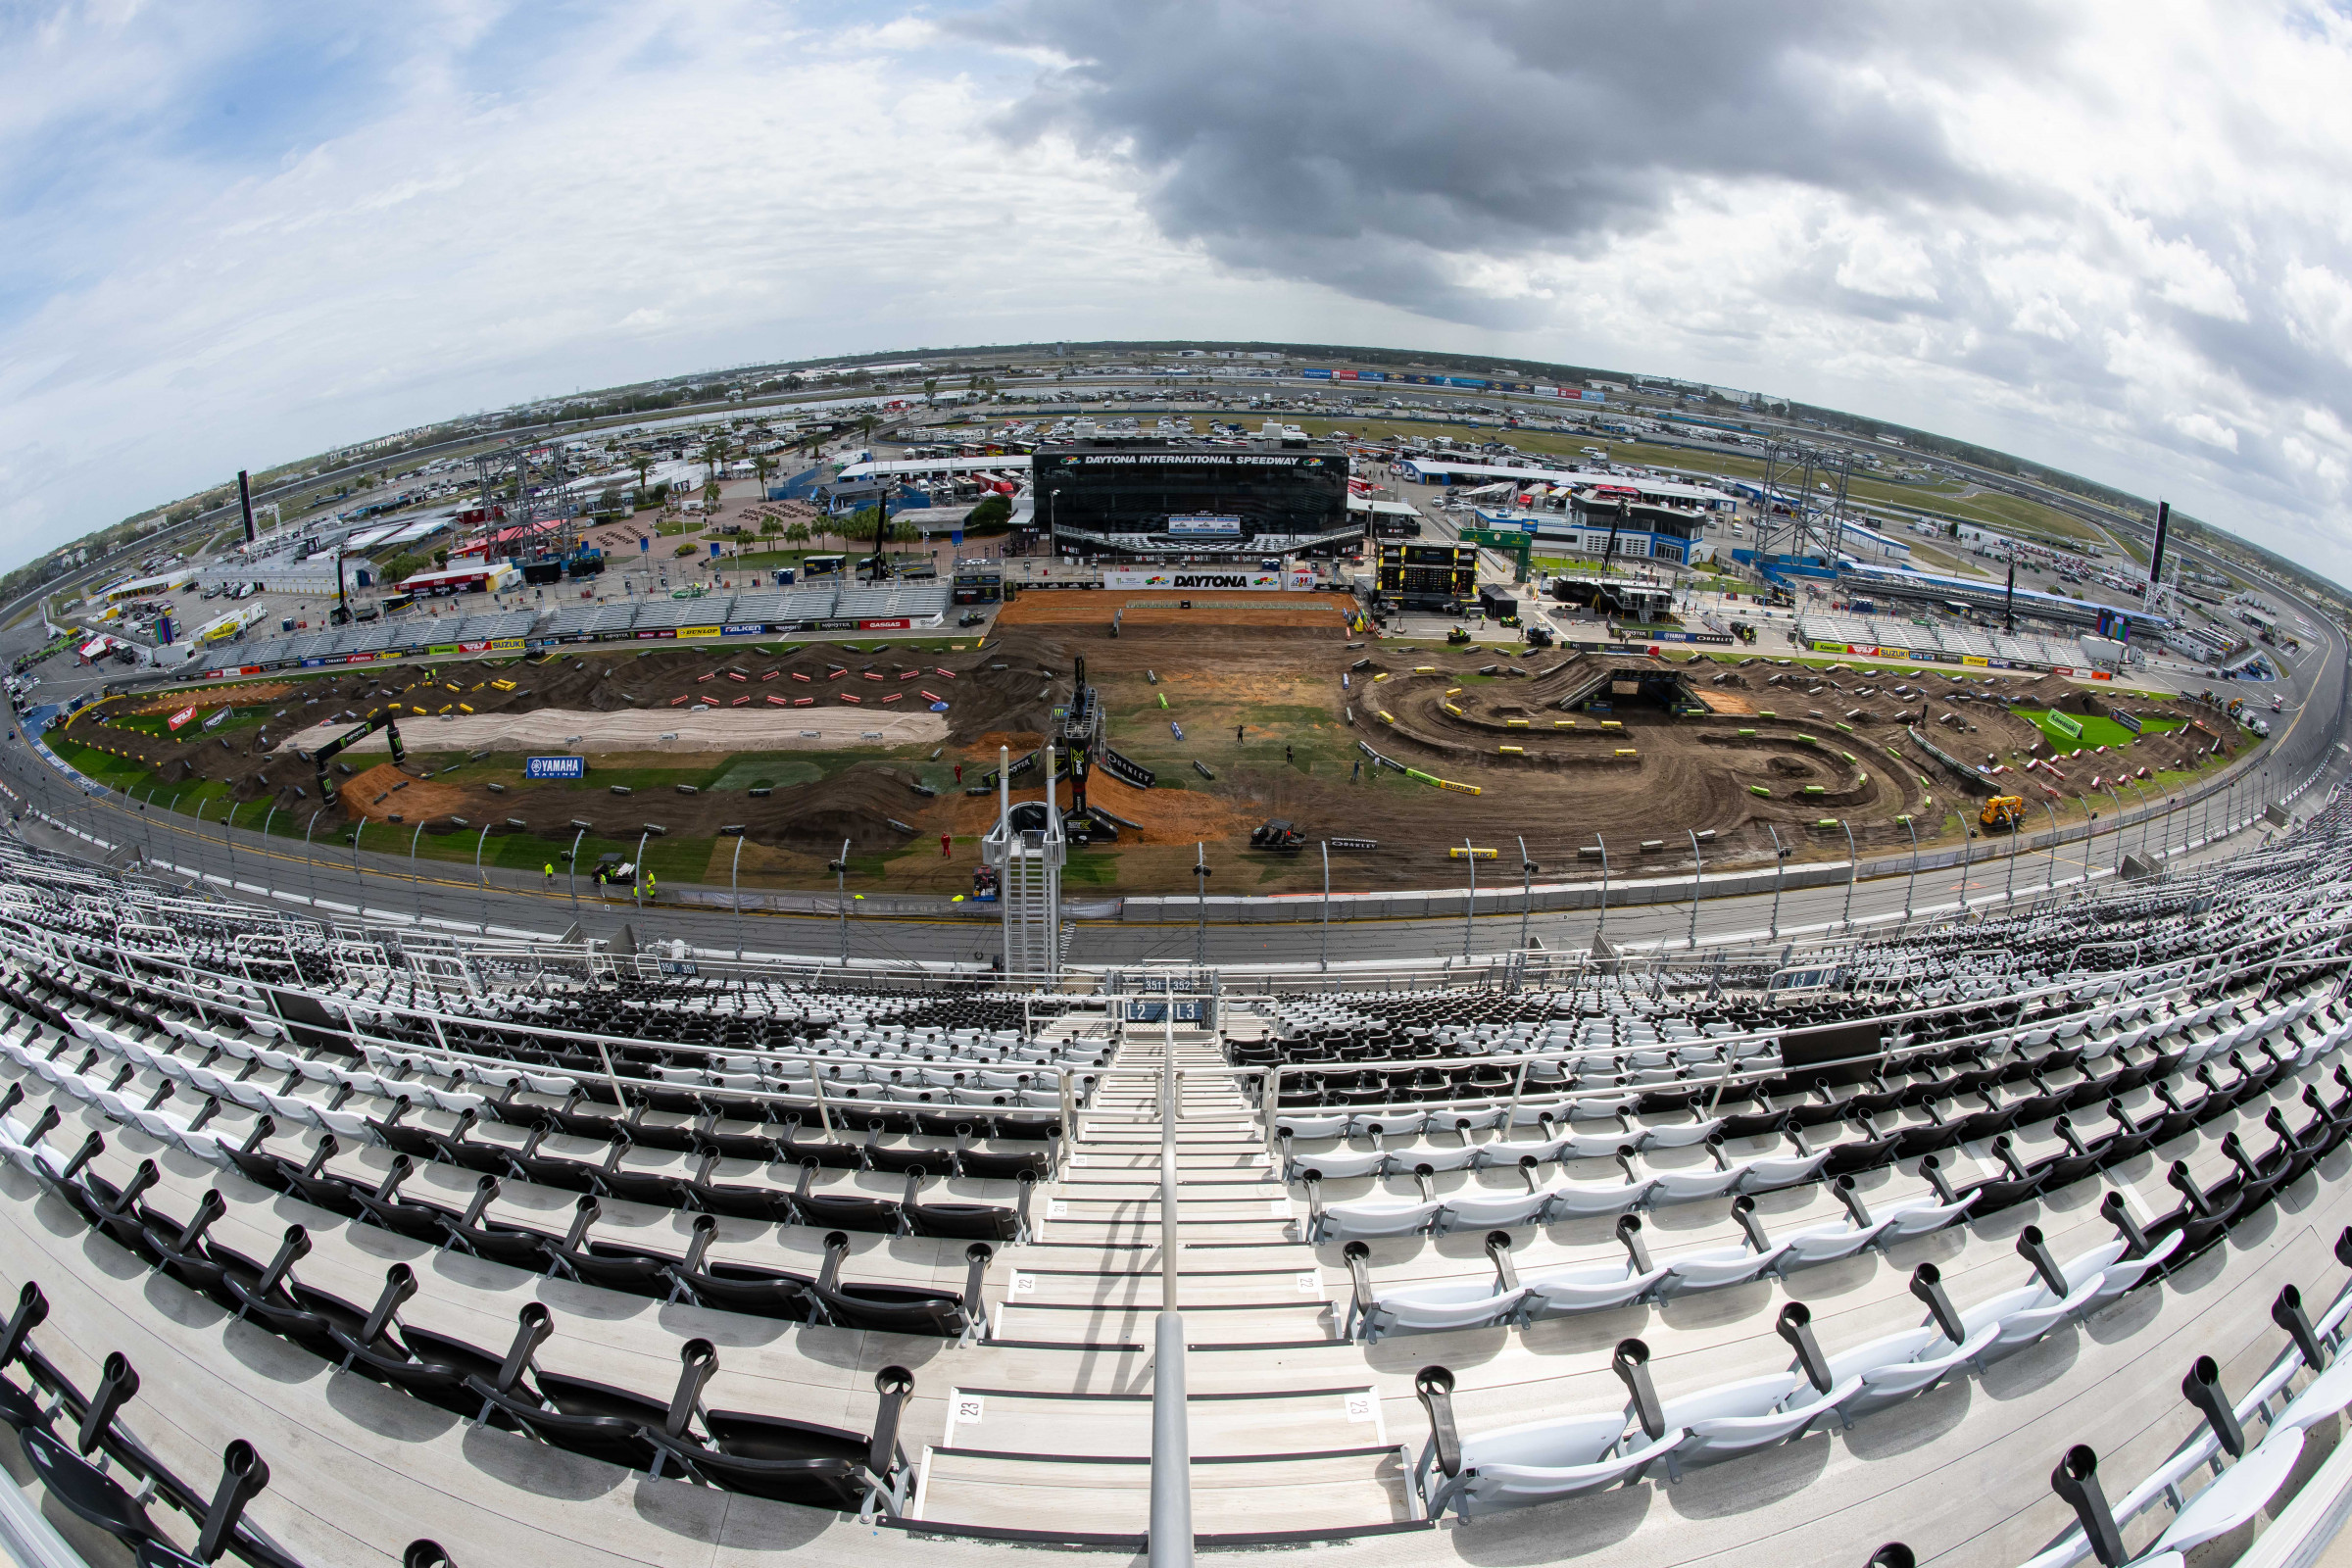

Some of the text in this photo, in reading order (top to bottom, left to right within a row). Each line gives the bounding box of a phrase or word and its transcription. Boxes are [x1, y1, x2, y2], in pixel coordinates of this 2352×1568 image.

[1085, 455, 1299, 466] DAYTONA INTERNATIONAL SPEEDWAY
[1174, 575, 1247, 588] DAYTONA
[725, 625, 761, 633] FALKEN
[492, 640, 524, 649] SUZUKI
[1880, 649, 1908, 658] SUZUKI
[171, 707, 194, 725] FLY
[205, 712, 225, 727] TRIUMPH
[2051, 713, 2078, 734] Kawasaki
[346, 727, 368, 742] MONSTER
[541, 759, 579, 772] YAMAHA
[1118, 760, 1150, 782] OAKLEY
[1445, 783, 1475, 794] SUZUKI
[661, 962, 696, 975] 350 351
[1146, 980, 1190, 990] 351 352
[1791, 974, 1806, 988] L3
[1127, 1004, 1195, 1020] L2 L3
[1018, 1279, 1032, 1289] 22
[1300, 1277, 1314, 1288] 22
[960, 1402, 979, 1417] 23
[1350, 1400, 1369, 1415] 23
